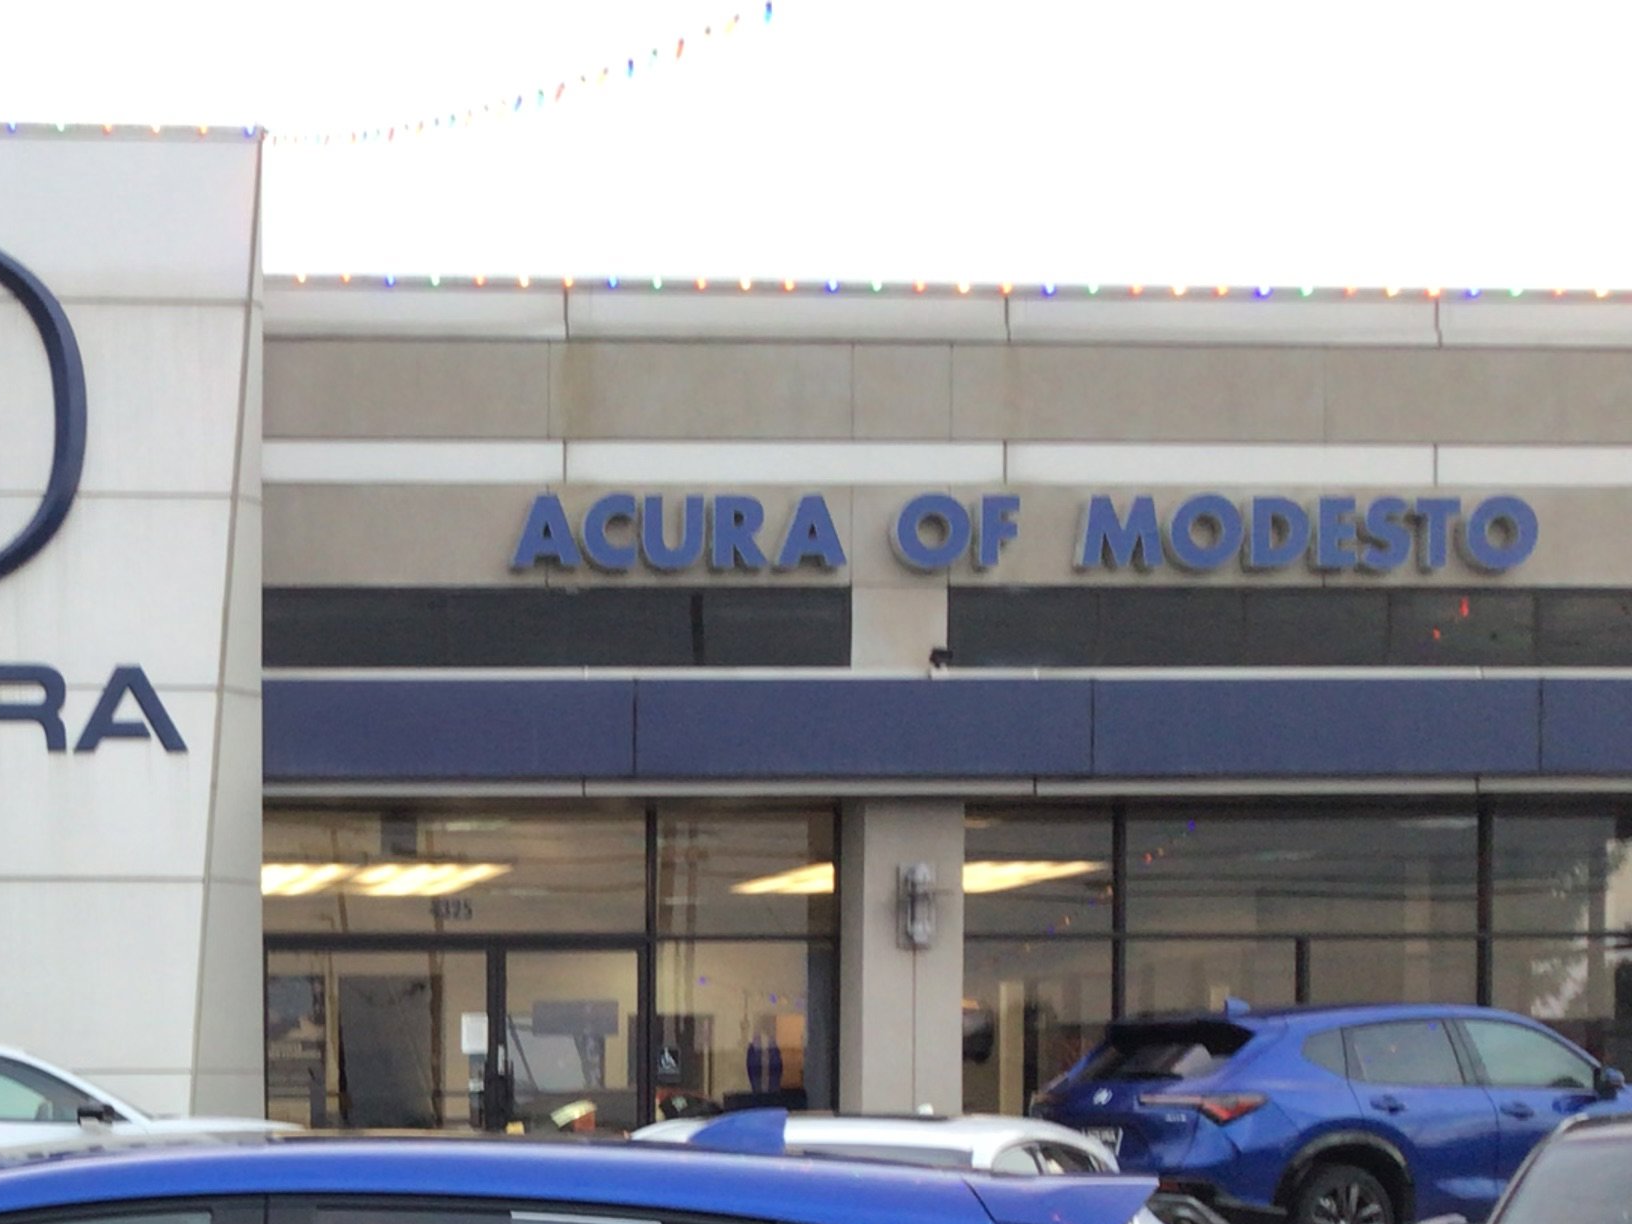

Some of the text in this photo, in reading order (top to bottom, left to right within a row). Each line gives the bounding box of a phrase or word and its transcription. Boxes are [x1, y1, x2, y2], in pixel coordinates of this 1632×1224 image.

[512, 493, 1539, 571] ACURA OF MODESTO
